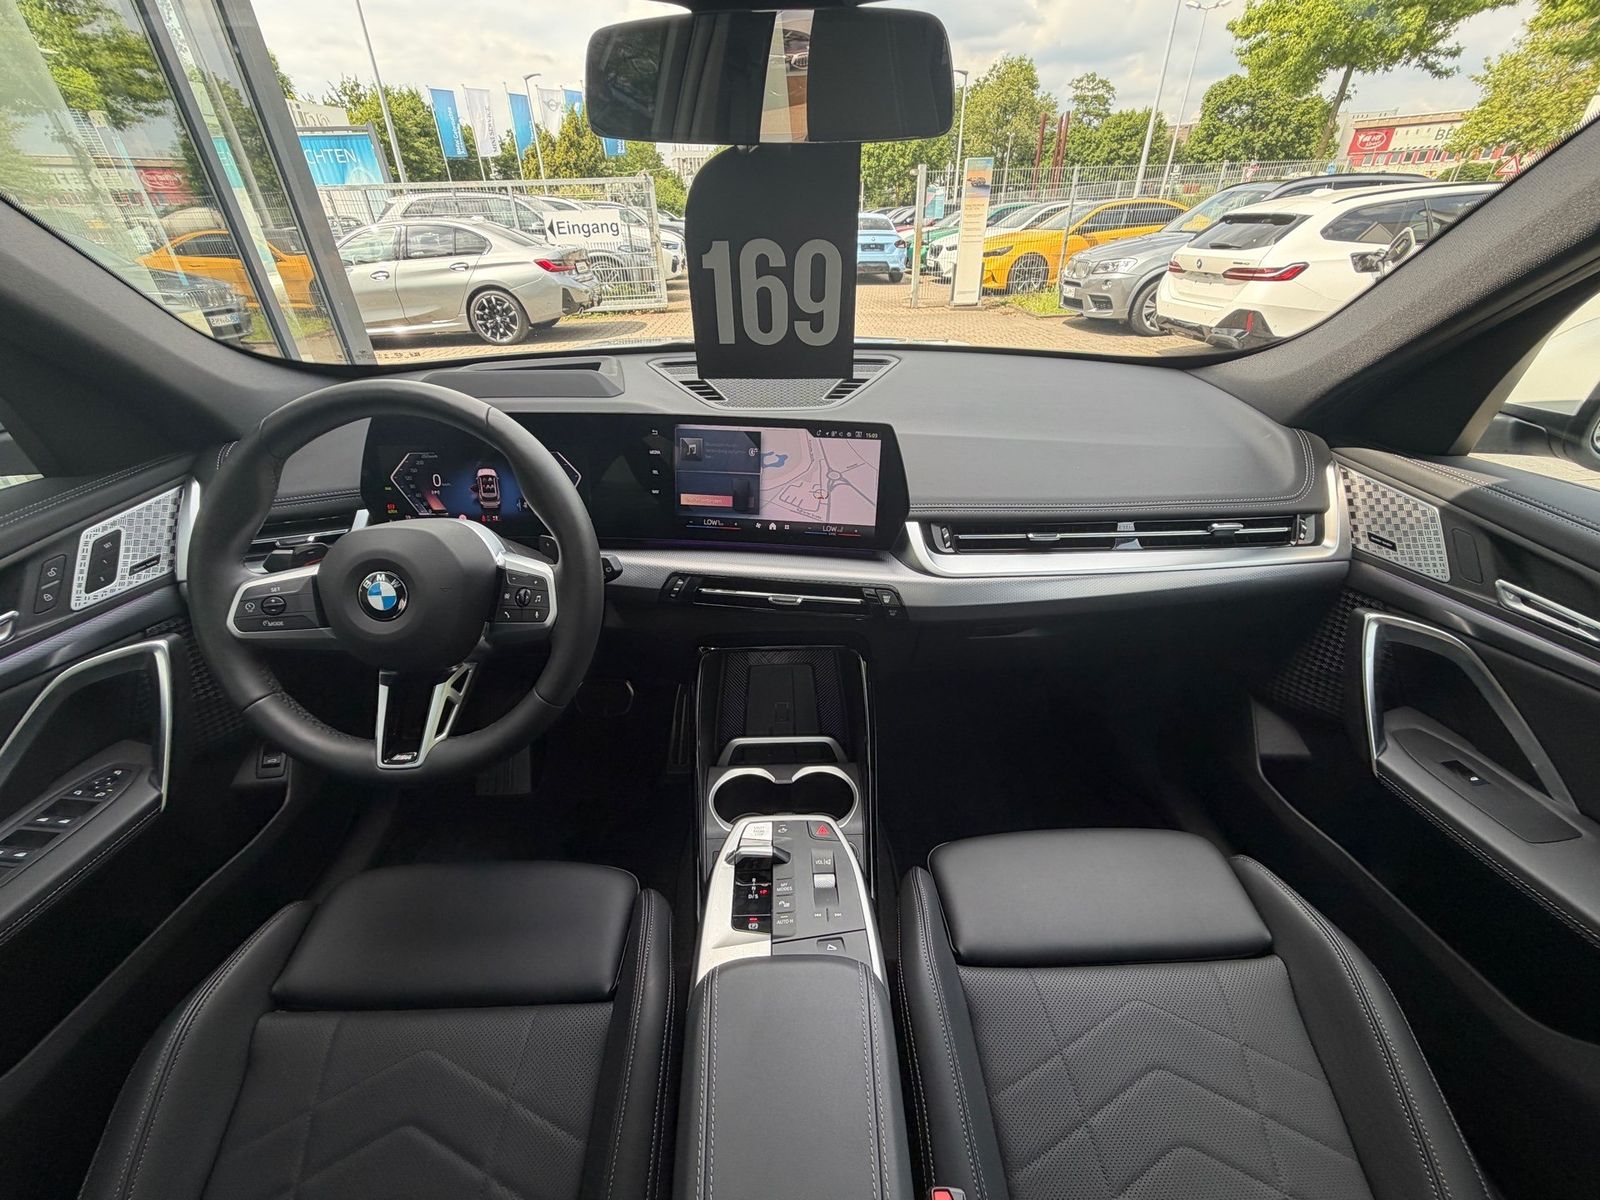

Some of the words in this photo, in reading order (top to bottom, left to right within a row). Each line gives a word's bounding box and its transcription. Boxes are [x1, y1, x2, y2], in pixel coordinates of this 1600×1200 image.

[556, 221, 620, 238] Eingang
[702, 238, 842, 346] 169
[432, 473, 442, 487] 0
[362, 573, 401, 589] BMW
